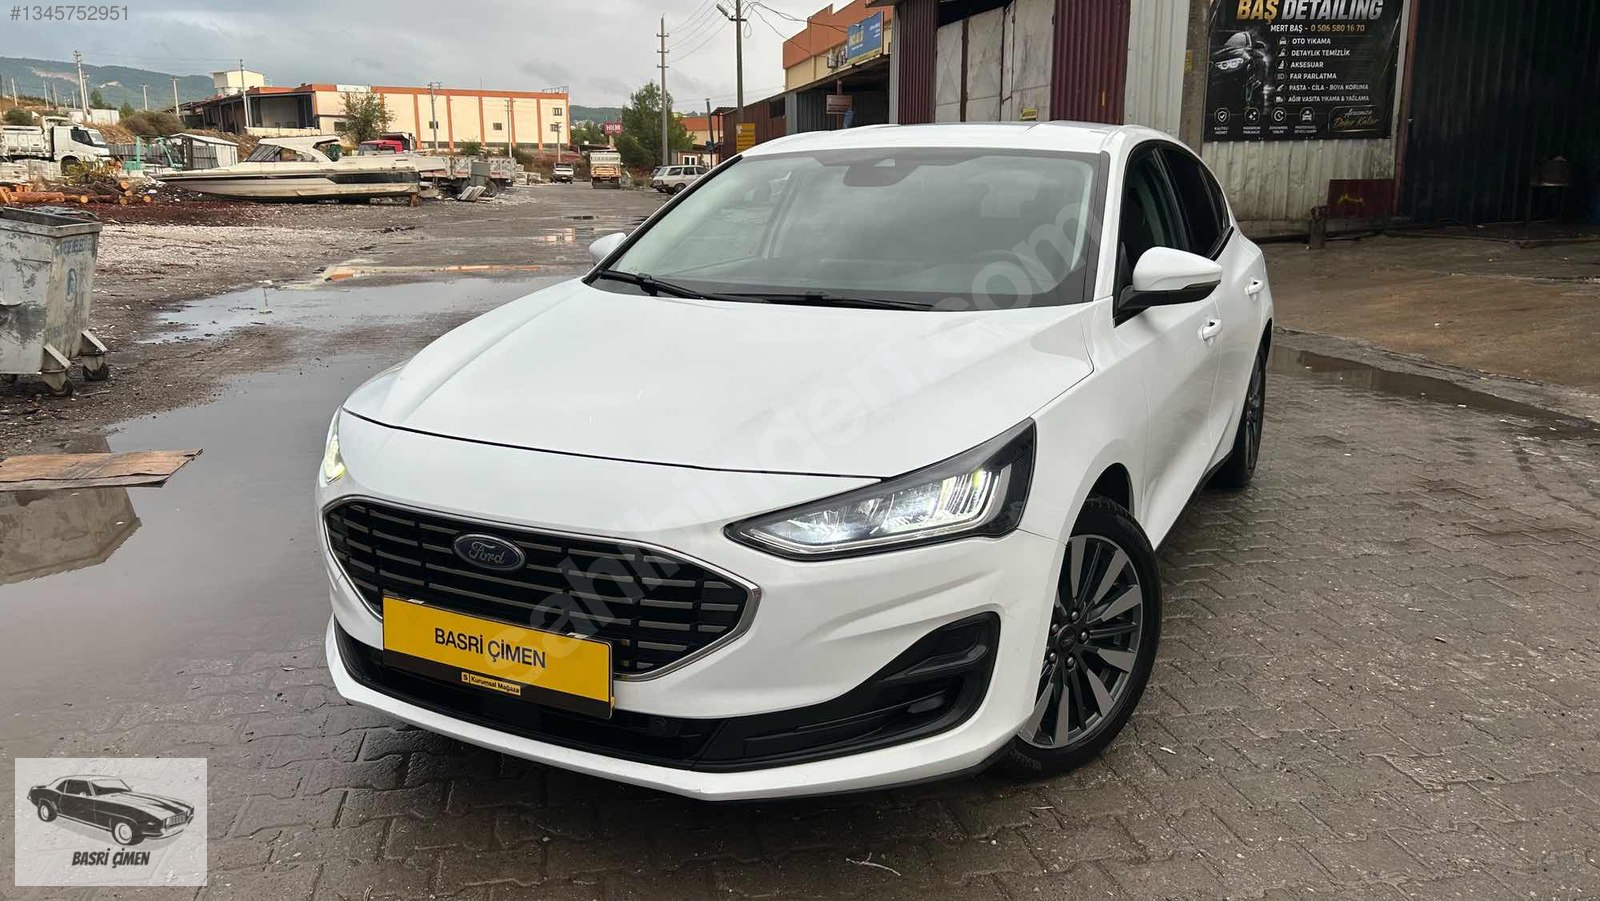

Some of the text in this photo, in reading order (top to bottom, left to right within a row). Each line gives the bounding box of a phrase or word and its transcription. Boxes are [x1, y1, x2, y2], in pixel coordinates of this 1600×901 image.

[1236, 0, 1384, 24] BAŞ DETAILING
[1270, 24, 1288, 32] MERT
[1290, 24, 1303, 34] BAŞ
[1310, 24, 1315, 32] 0
[1317, 24, 1331, 32] 506
[1332, 24, 1345, 32] 580
[1347, 24, 1355, 32] 16
[1356, 24, 1365, 32] 70
[1322, 48, 1351, 56] TEMİZLİK
[1311, 83, 1325, 91] CİLA
[468, 541, 505, 564] Ford
[434, 627, 546, 669] BASRİ ÇİMEN
[471, 675, 497, 688] Kurumsal
[497, 682, 520, 694] Mağaza
